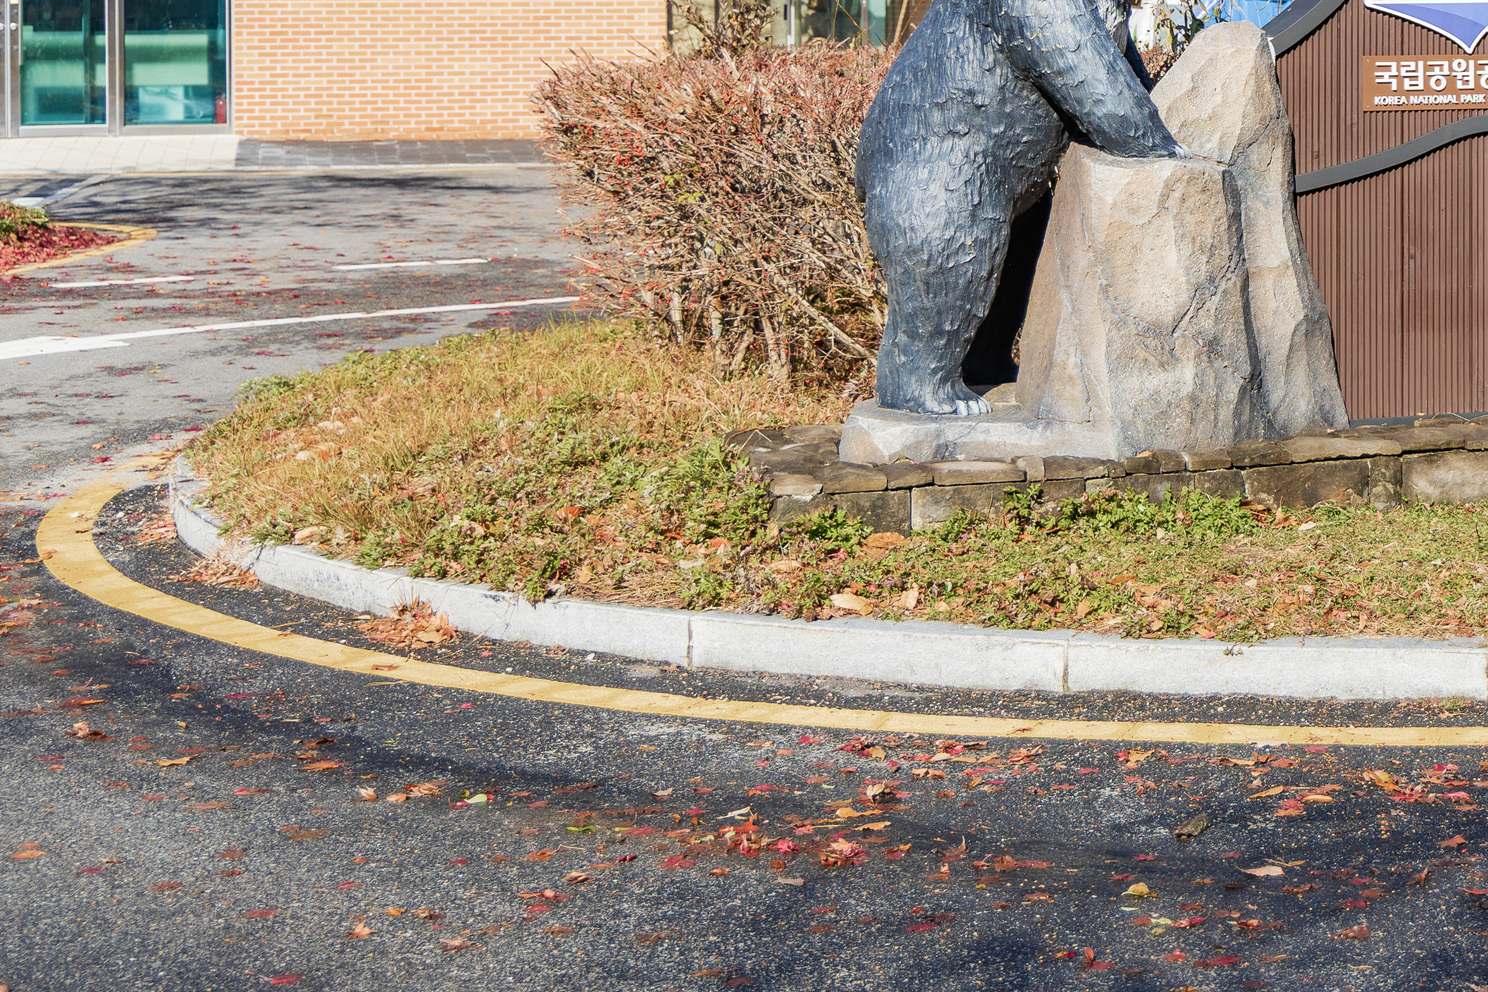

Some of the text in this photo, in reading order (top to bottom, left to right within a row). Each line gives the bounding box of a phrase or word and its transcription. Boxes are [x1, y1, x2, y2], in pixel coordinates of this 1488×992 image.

[1374, 96, 1408, 105] KOREA
[1410, 95, 1459, 105] NATIONAL
[1460, 94, 1486, 104] PARK
